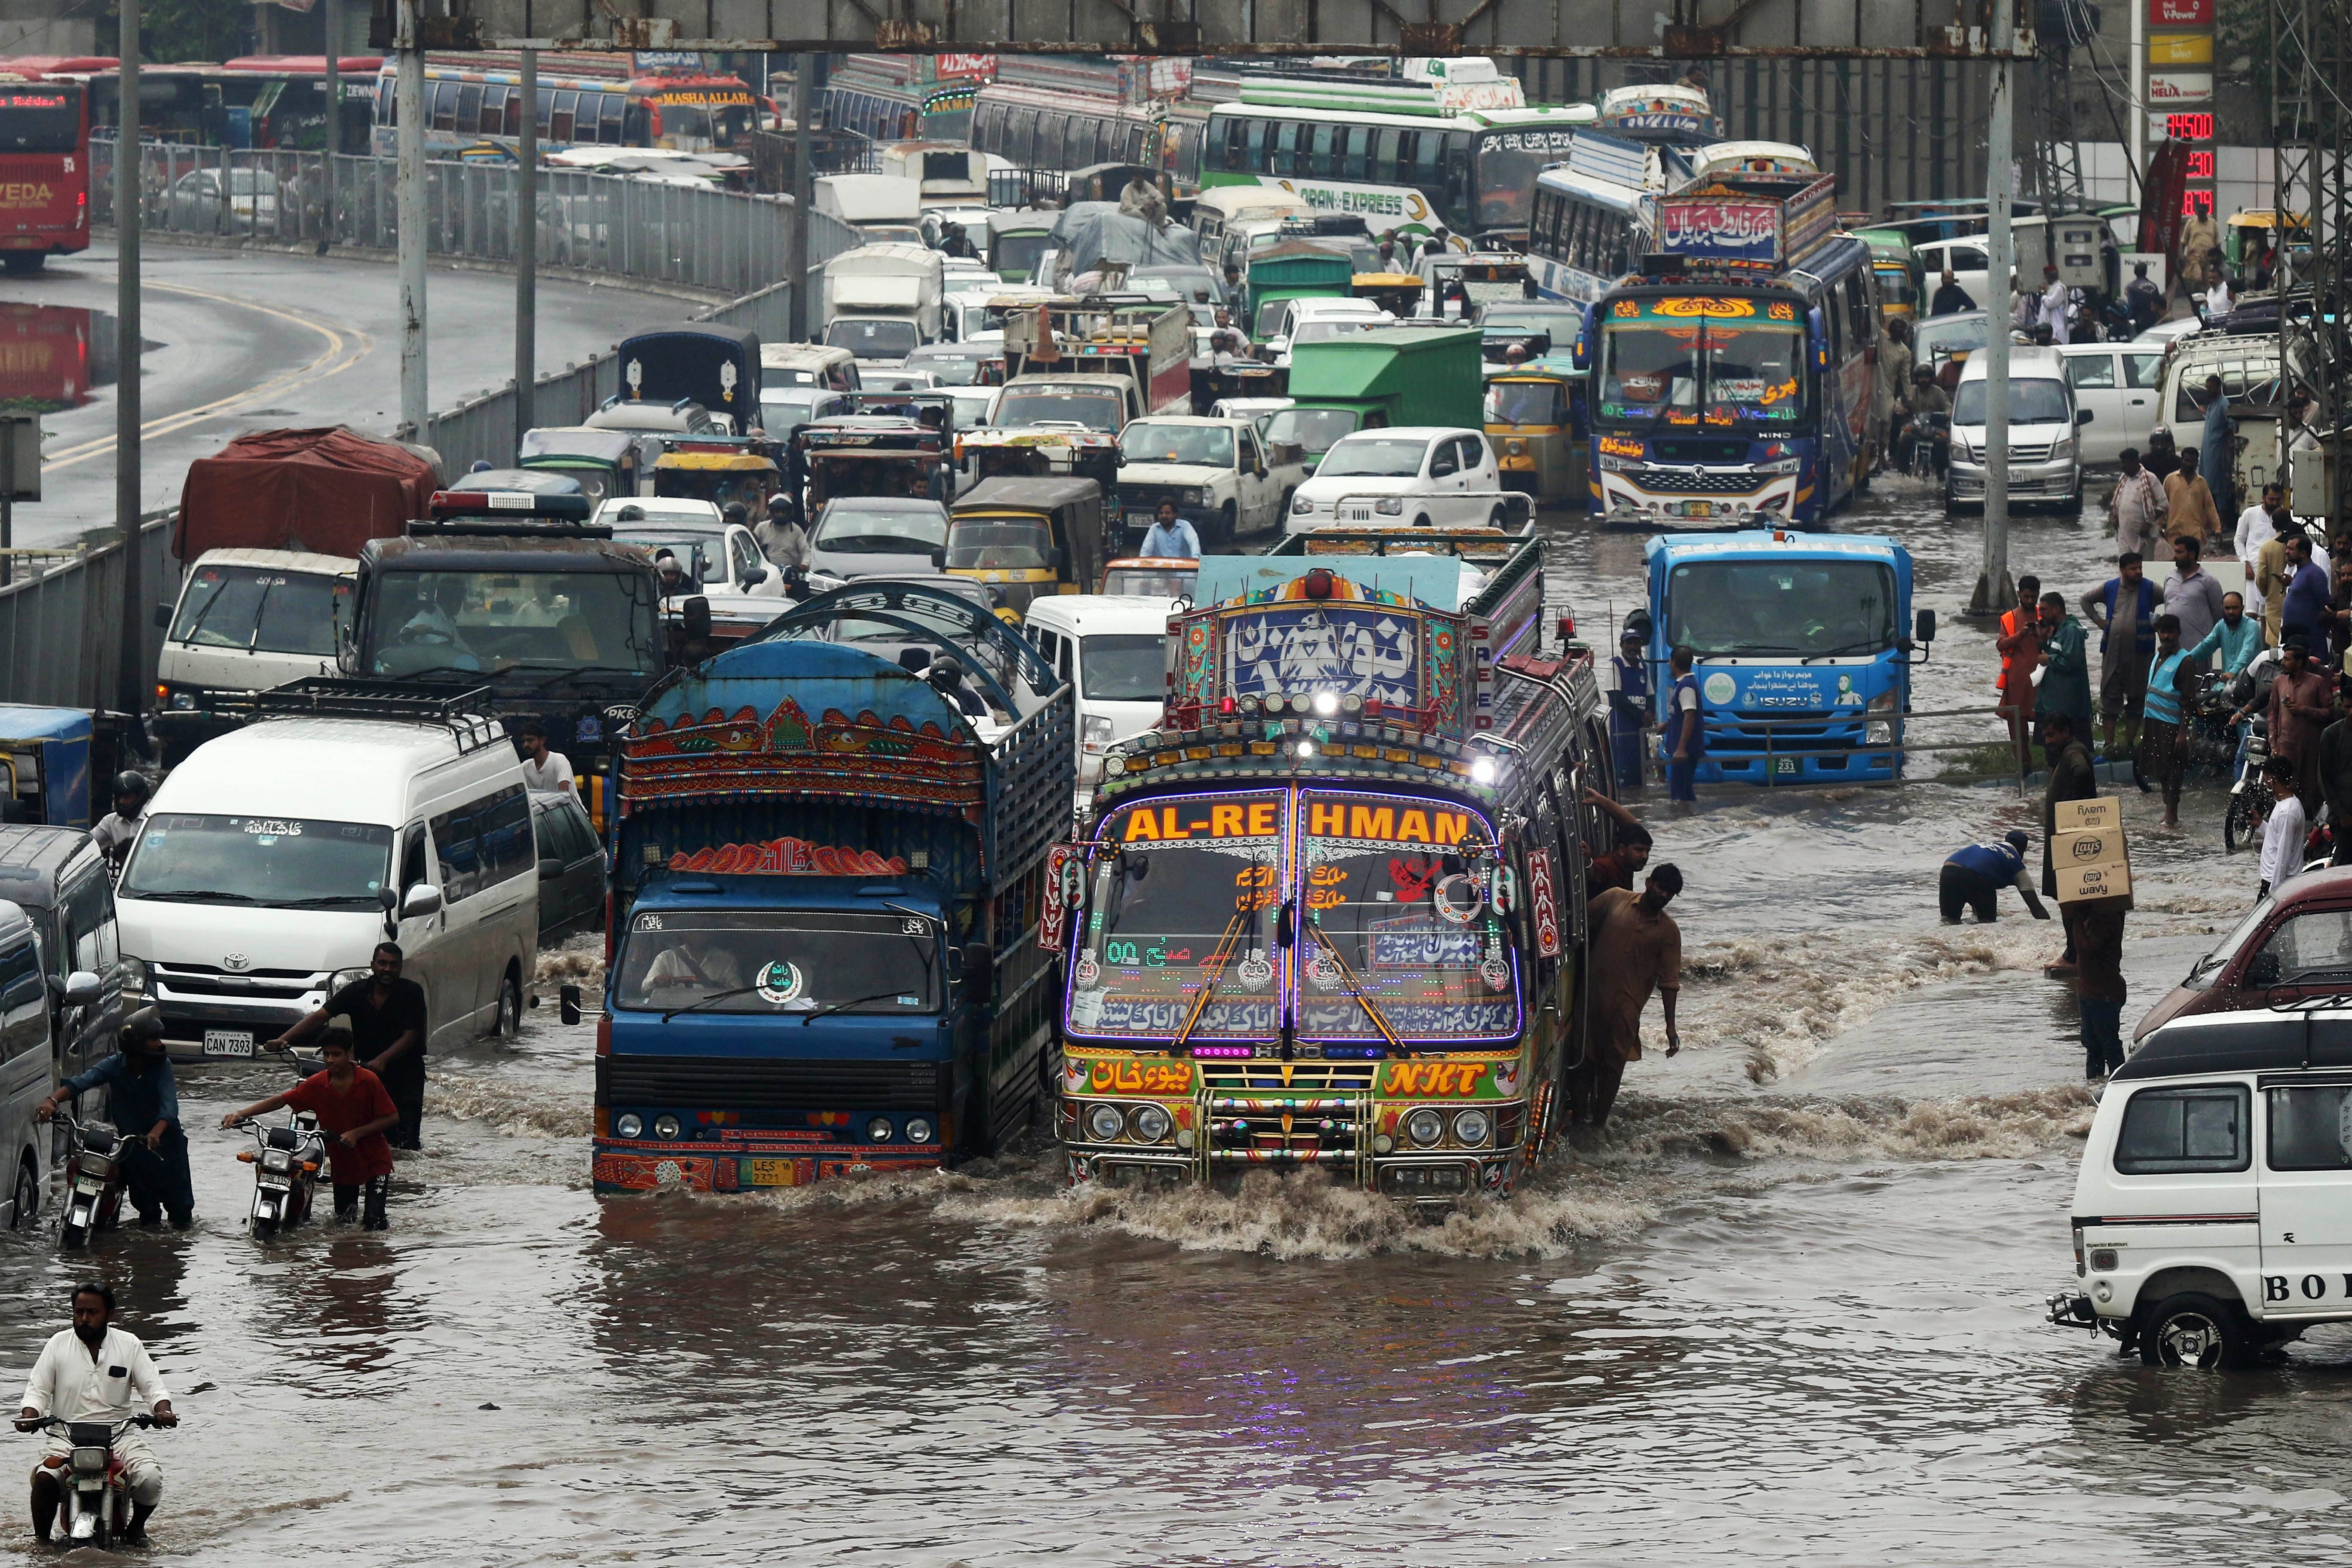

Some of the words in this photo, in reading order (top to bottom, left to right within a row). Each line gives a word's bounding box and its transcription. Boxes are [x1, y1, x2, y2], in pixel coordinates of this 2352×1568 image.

[2163, 10, 2196, 19] V-Power
[2152, 83, 2180, 97] HELIX
[663, 92, 707, 104] MASHA
[709, 92, 748, 104] ALLAH
[1343, 191, 1403, 215] EXPRESS
[1760, 697, 1807, 706] ISUZU
[2077, 805, 2106, 816] wavy
[1124, 803, 1276, 841] AL-RE
[1311, 803, 1468, 845] HMAN
[1310, 865, 1348, 886] ملک
[2079, 884, 2108, 895] wavy
[1308, 889, 1347, 910] ملک
[207, 1038, 225, 1051] CAN
[229, 1039, 250, 1053] 7393
[1384, 1062, 1488, 1097] NKT
[754, 1161, 775, 1172] LES
[80, 1177, 89, 1185] LEL
[753, 1173, 779, 1184] 2321
